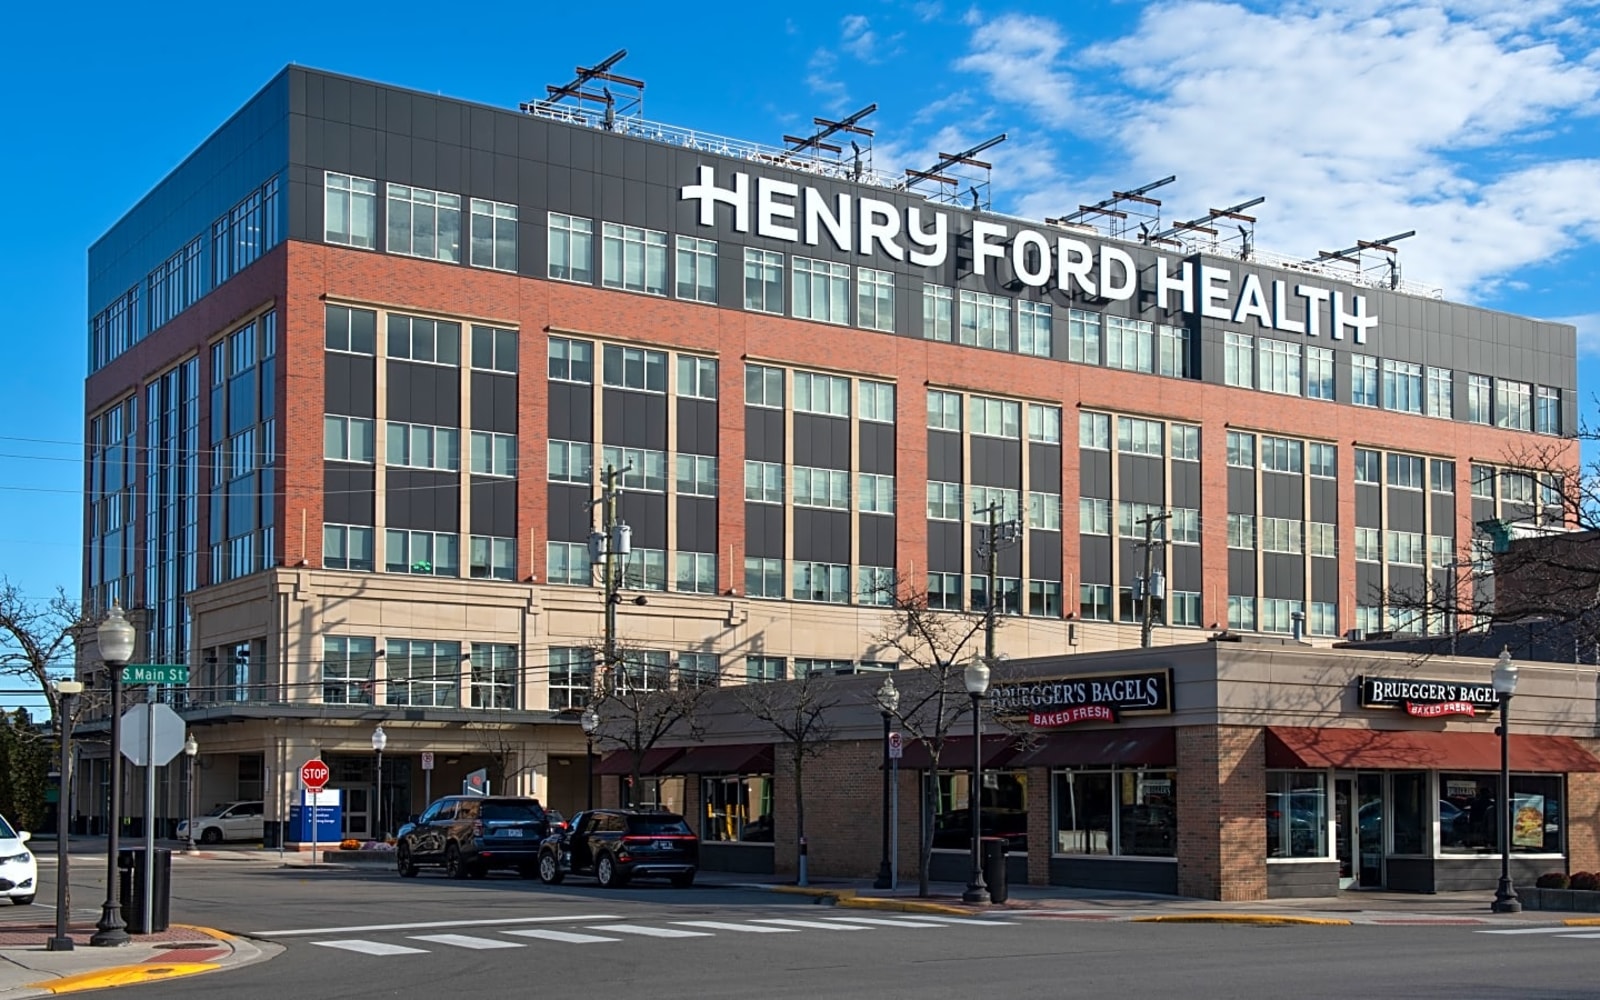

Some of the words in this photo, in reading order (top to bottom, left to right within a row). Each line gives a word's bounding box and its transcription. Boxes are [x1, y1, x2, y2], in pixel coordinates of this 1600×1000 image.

[681, 165, 948, 268] HENRY
[971, 219, 1137, 300] FORD
[1155, 256, 1379, 344] HEALTH
[135, 668, 164, 680] Main
[169, 668, 184, 681] St
[1091, 677, 1159, 706] BAGELS
[1373, 680, 1457, 702] BRUEGGER'S
[1460, 687, 1500, 703] BAGEL
[1033, 712, 1070, 725] BAKED
[1073, 706, 1110, 720] FRESH
[1411, 705, 1441, 715] BAKED
[303, 768, 328, 779] STOP
